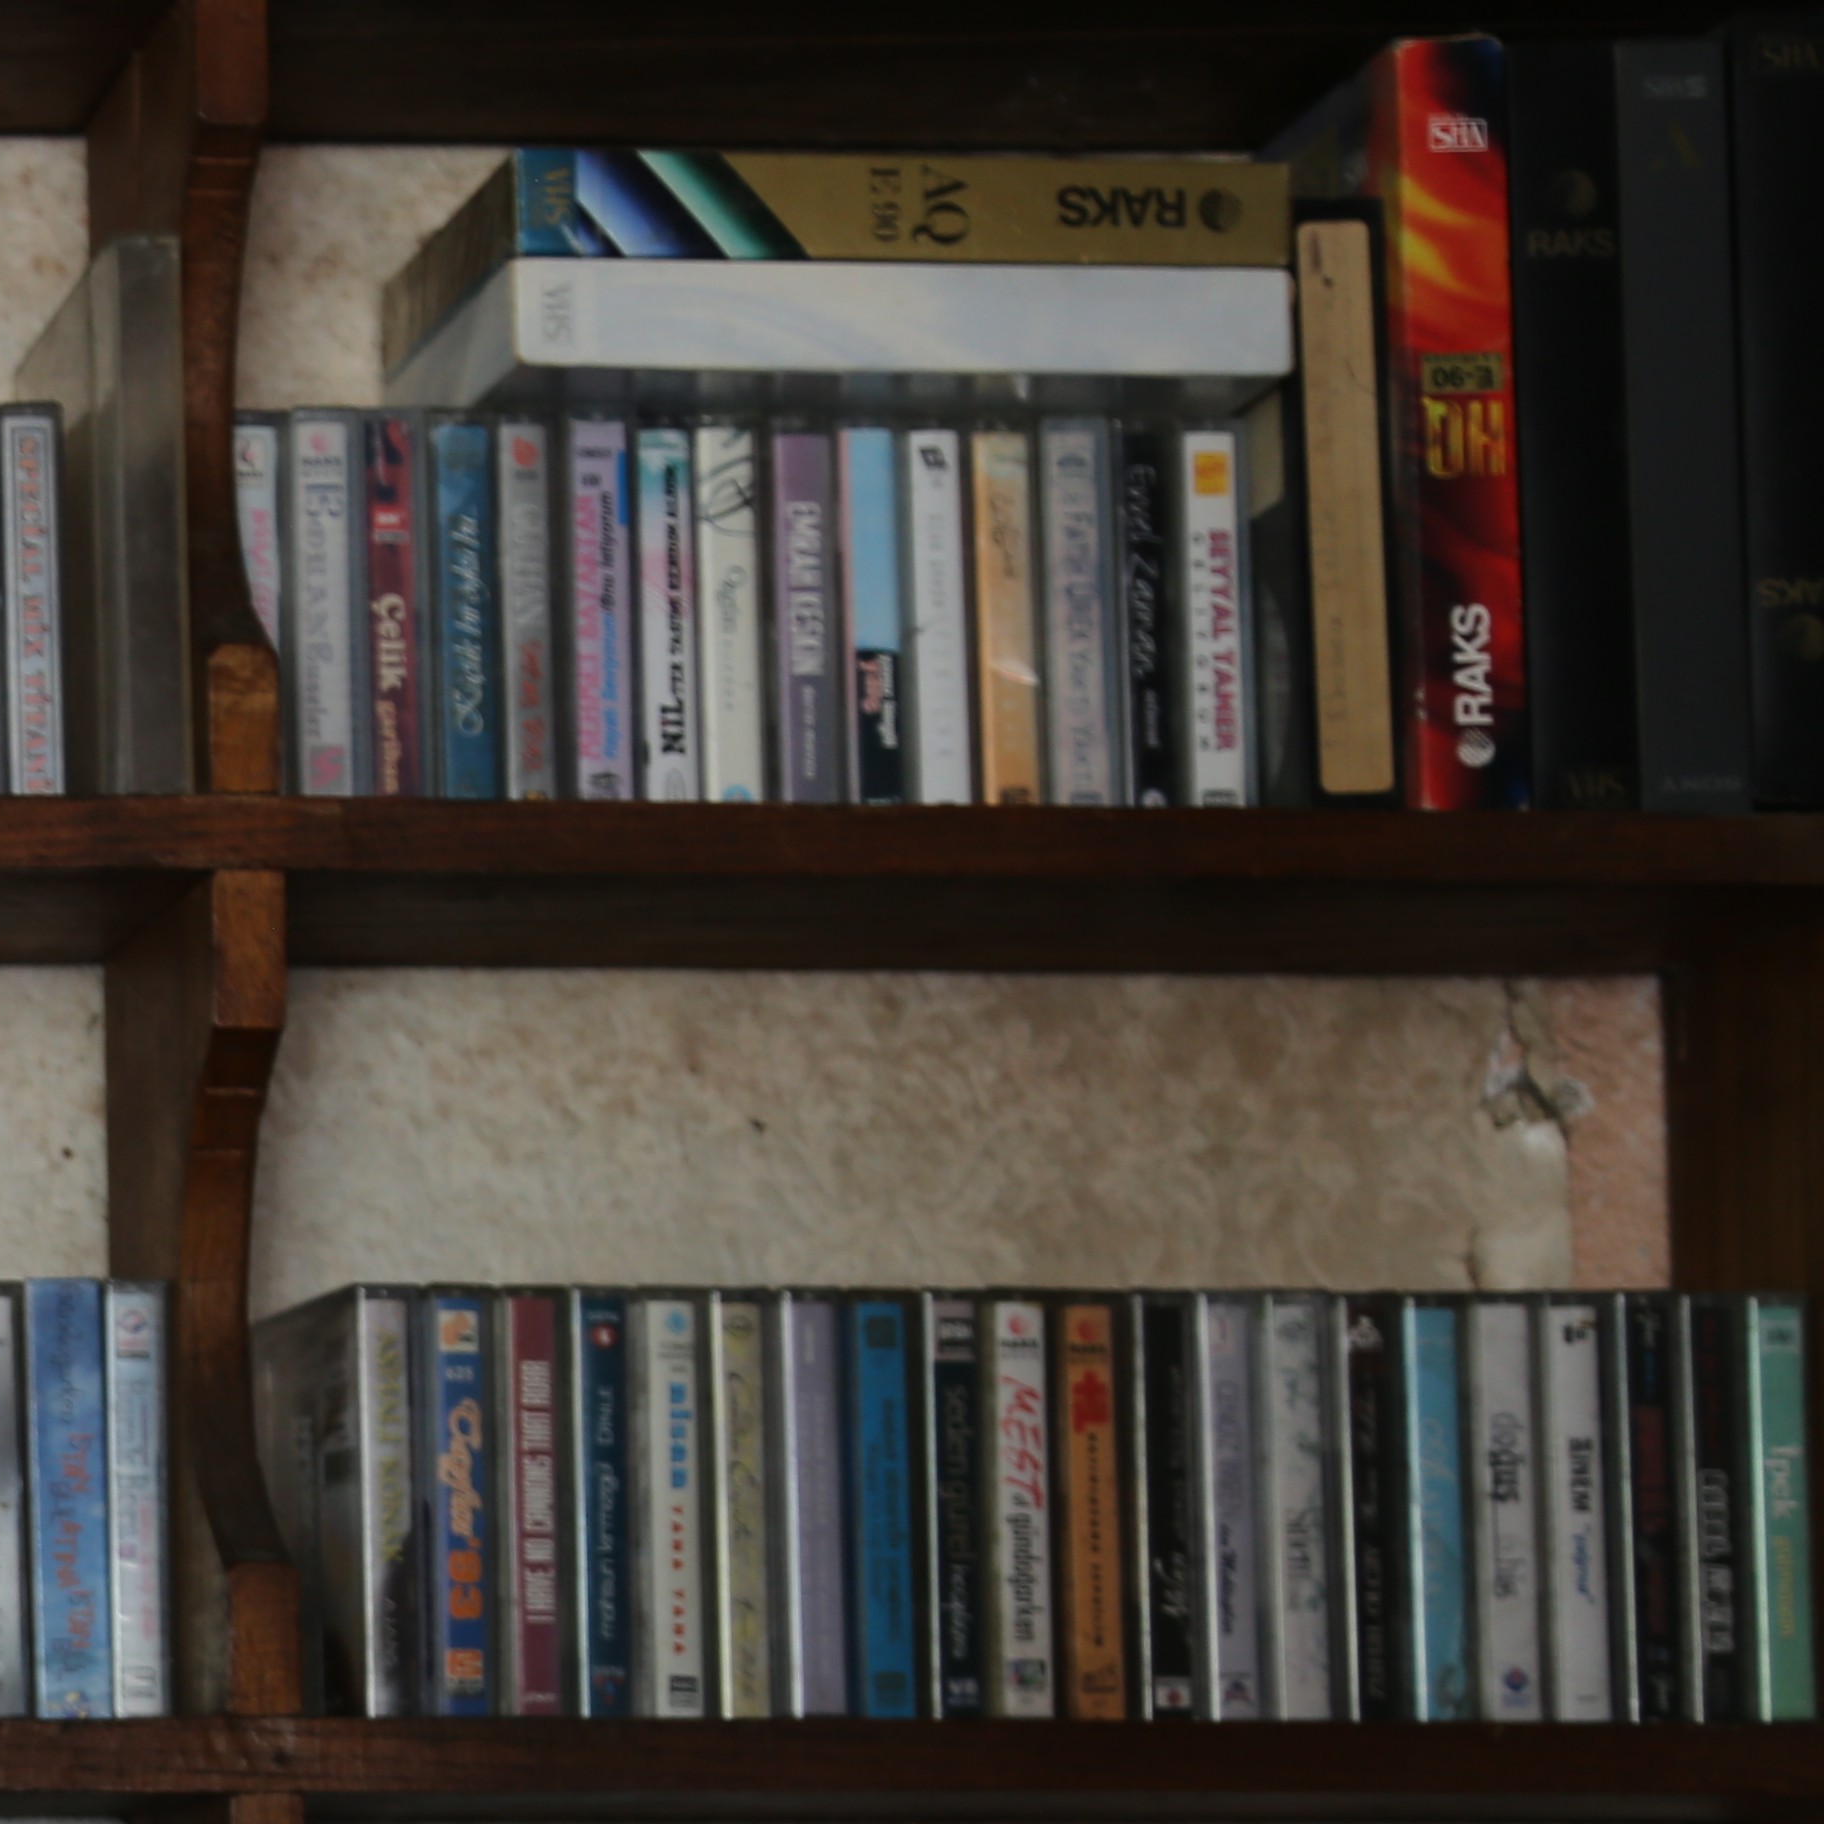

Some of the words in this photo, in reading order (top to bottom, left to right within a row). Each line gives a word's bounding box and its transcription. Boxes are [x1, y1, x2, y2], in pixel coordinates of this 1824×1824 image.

[913, 164, 971, 247] AQ
[1058, 187, 1185, 227] RAKS
[1423, 399, 1505, 477] HQ
[23, 592, 51, 659] MİX
[370, 592, 407, 692] Çelik
[1450, 603, 1494, 726] RAKS
[520, 1361, 552, 1405] ROAR
[521, 1411, 552, 1450] THAT
[524, 1539, 554, 1562] NO
[672, 1505, 685, 1570] YANA
[524, 1569, 555, 1609] HAVE
[672, 1588, 686, 1655] YANA
